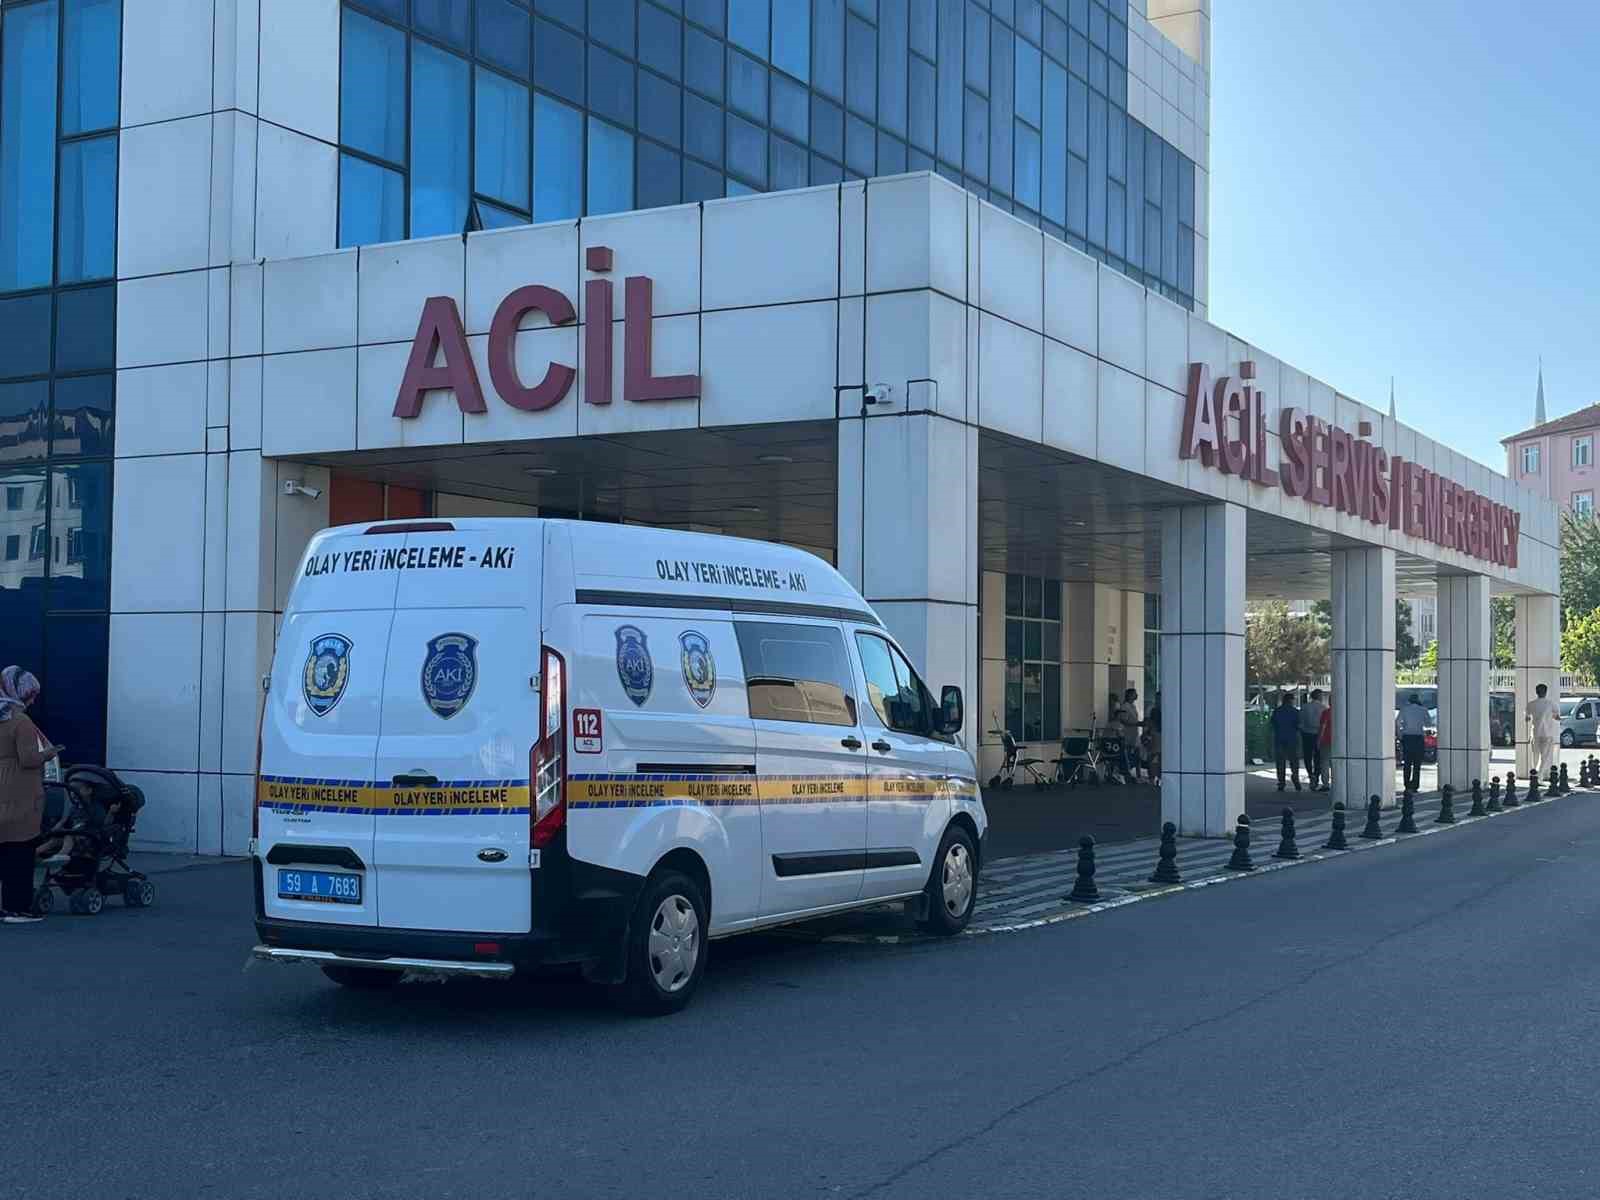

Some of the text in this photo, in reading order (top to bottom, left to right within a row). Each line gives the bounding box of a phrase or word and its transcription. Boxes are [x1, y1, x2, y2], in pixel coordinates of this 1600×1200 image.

[393, 246, 701, 418] ACİL
[1179, 361, 1280, 487] ACİL
[1280, 407, 1388, 525] SERVİS
[1403, 462, 1520, 568] EMERGENCY
[305, 553, 341, 577] OLAY
[656, 559, 692, 582] OLAY
[577, 713, 599, 735] 112
[269, 785, 290, 799] OLAY
[393, 792, 421, 806] OLAY
[587, 784, 609, 797] OLAY
[688, 784, 705, 796] OLAY
[286, 873, 357, 897] 59 A 7683
